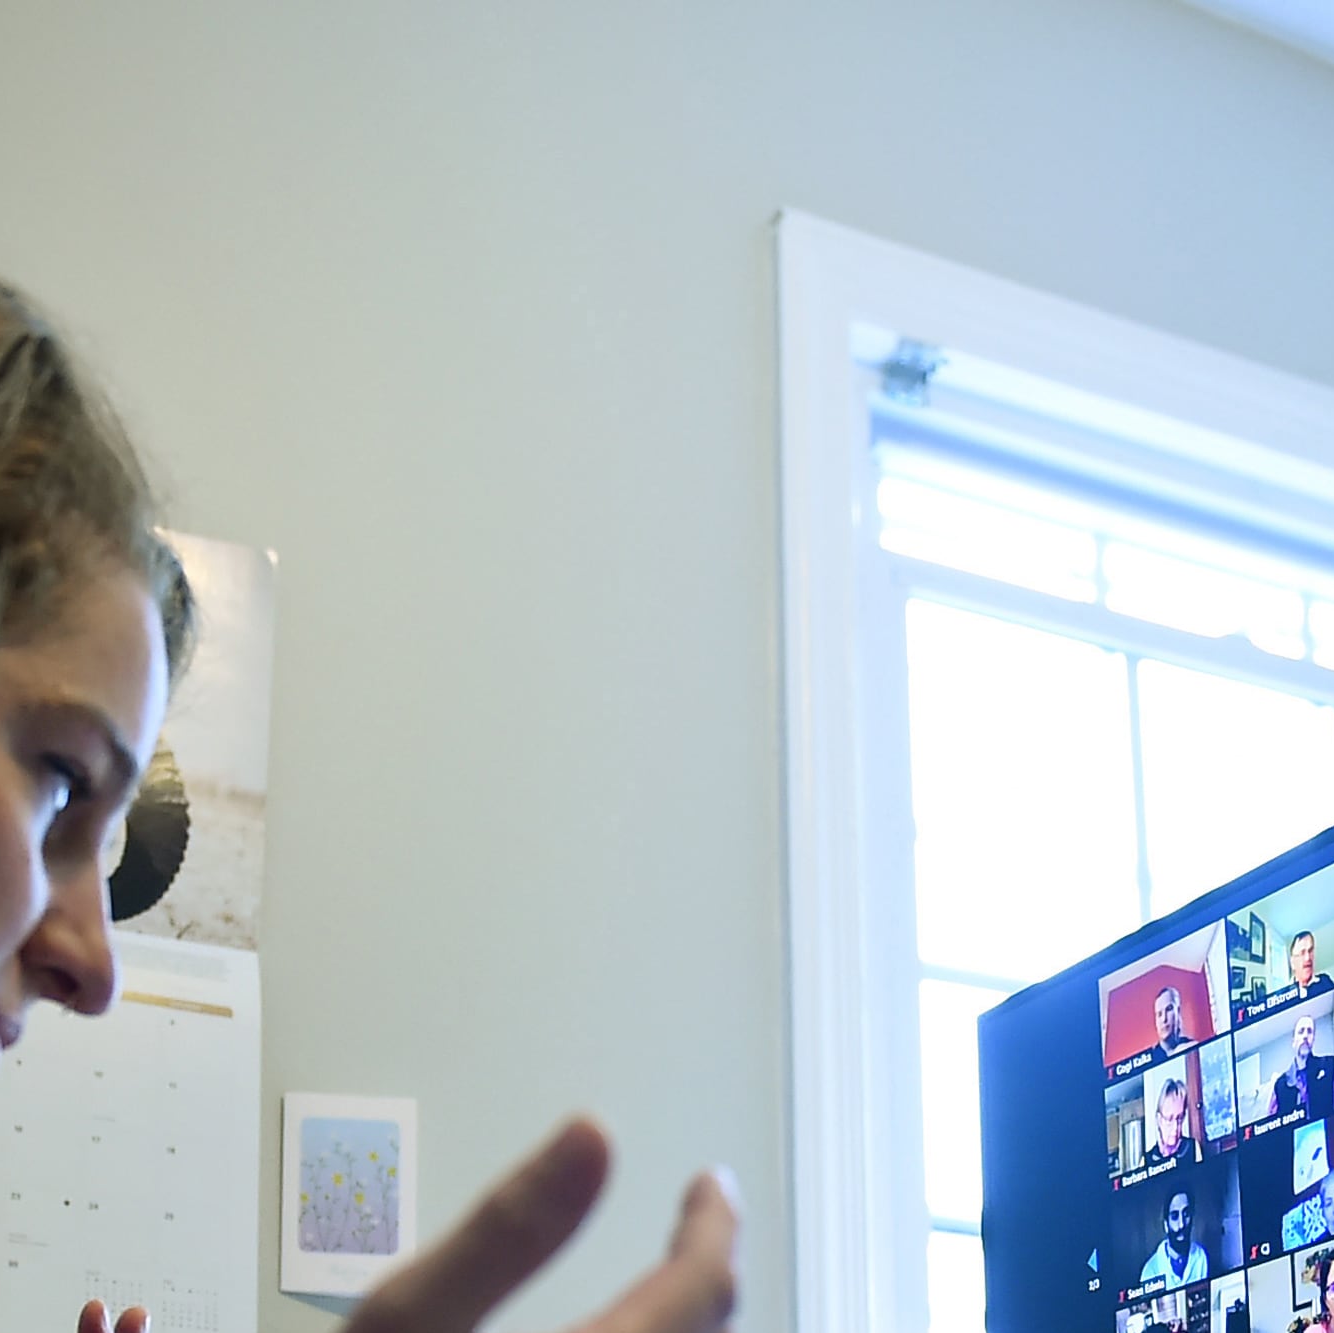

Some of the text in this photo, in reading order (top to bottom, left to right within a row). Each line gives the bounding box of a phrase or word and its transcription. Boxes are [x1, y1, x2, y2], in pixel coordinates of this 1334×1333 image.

[1246, 1002, 1266, 1017] Tove
[1254, 1106, 1305, 1136] laurent andre
[1121, 1157, 1177, 1188] Barbara Bancroft
[1127, 1286, 1144, 1300] Sean
